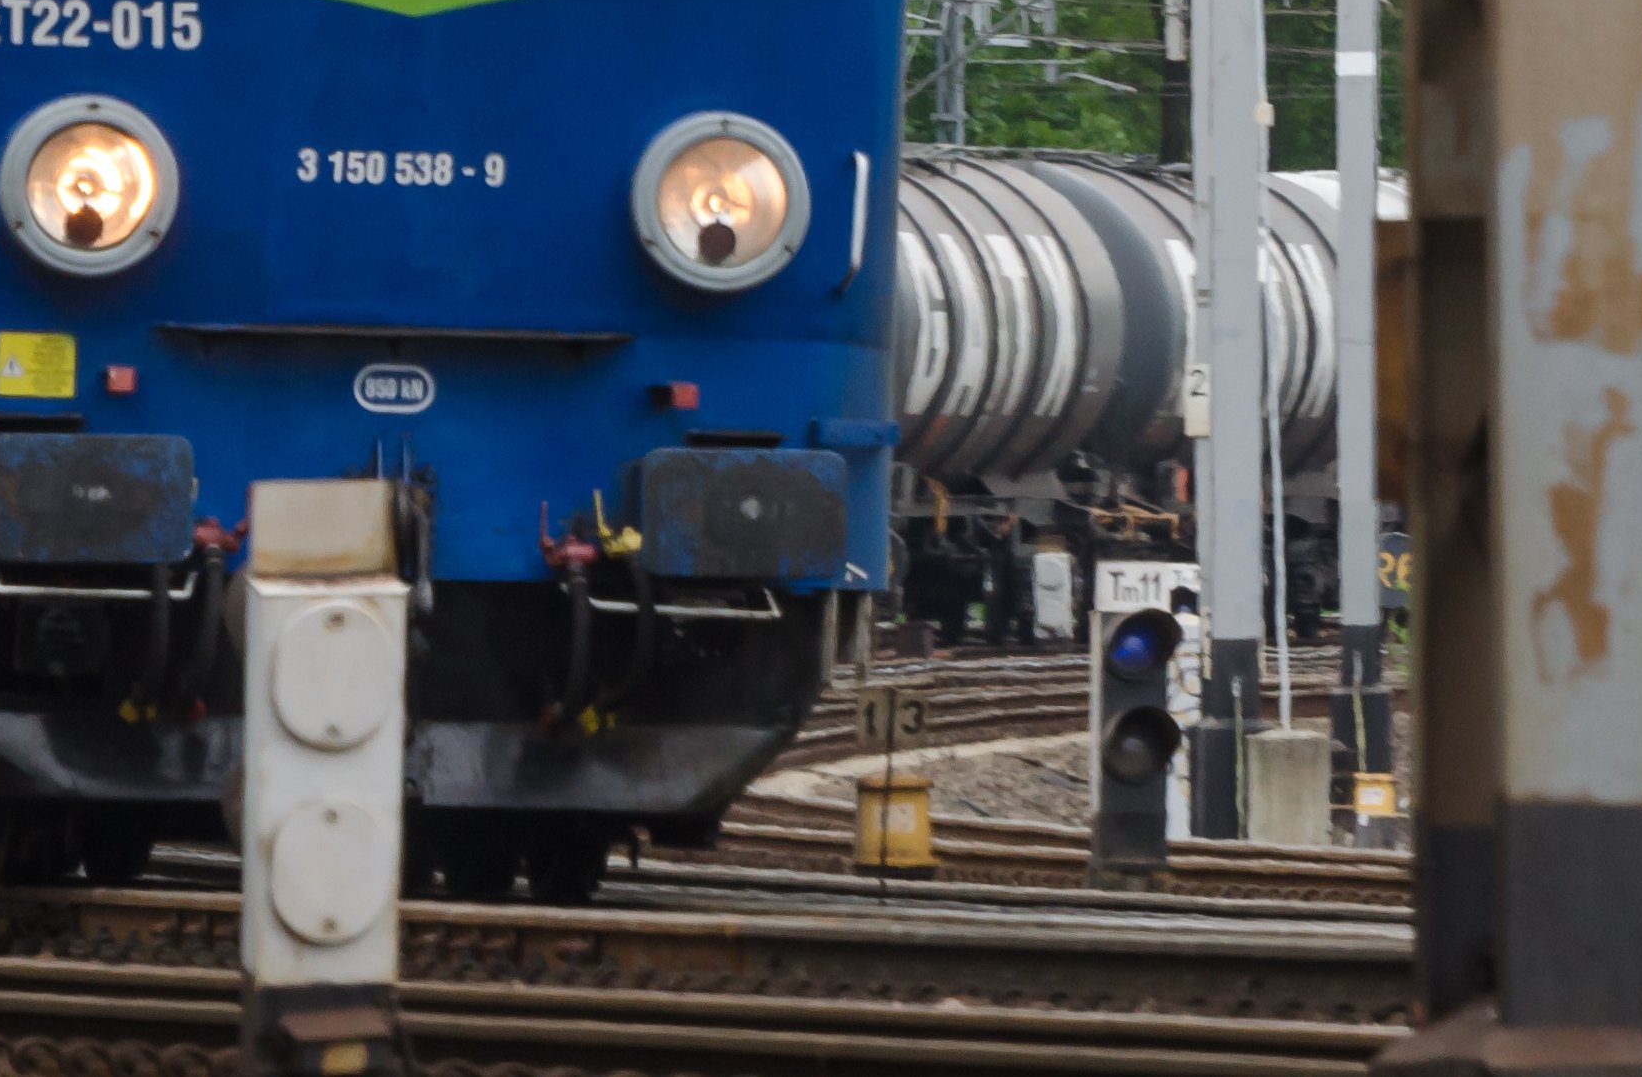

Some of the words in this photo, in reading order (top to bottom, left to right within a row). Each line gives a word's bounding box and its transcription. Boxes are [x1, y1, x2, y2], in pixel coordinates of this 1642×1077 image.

[296, 146, 319, 183] 3
[327, 149, 386, 185] 150
[394, 151, 454, 188] 538
[484, 152, 506, 188] 9
[1188, 369, 1208, 397] 2
[1107, 571, 1162, 603] Tm11
